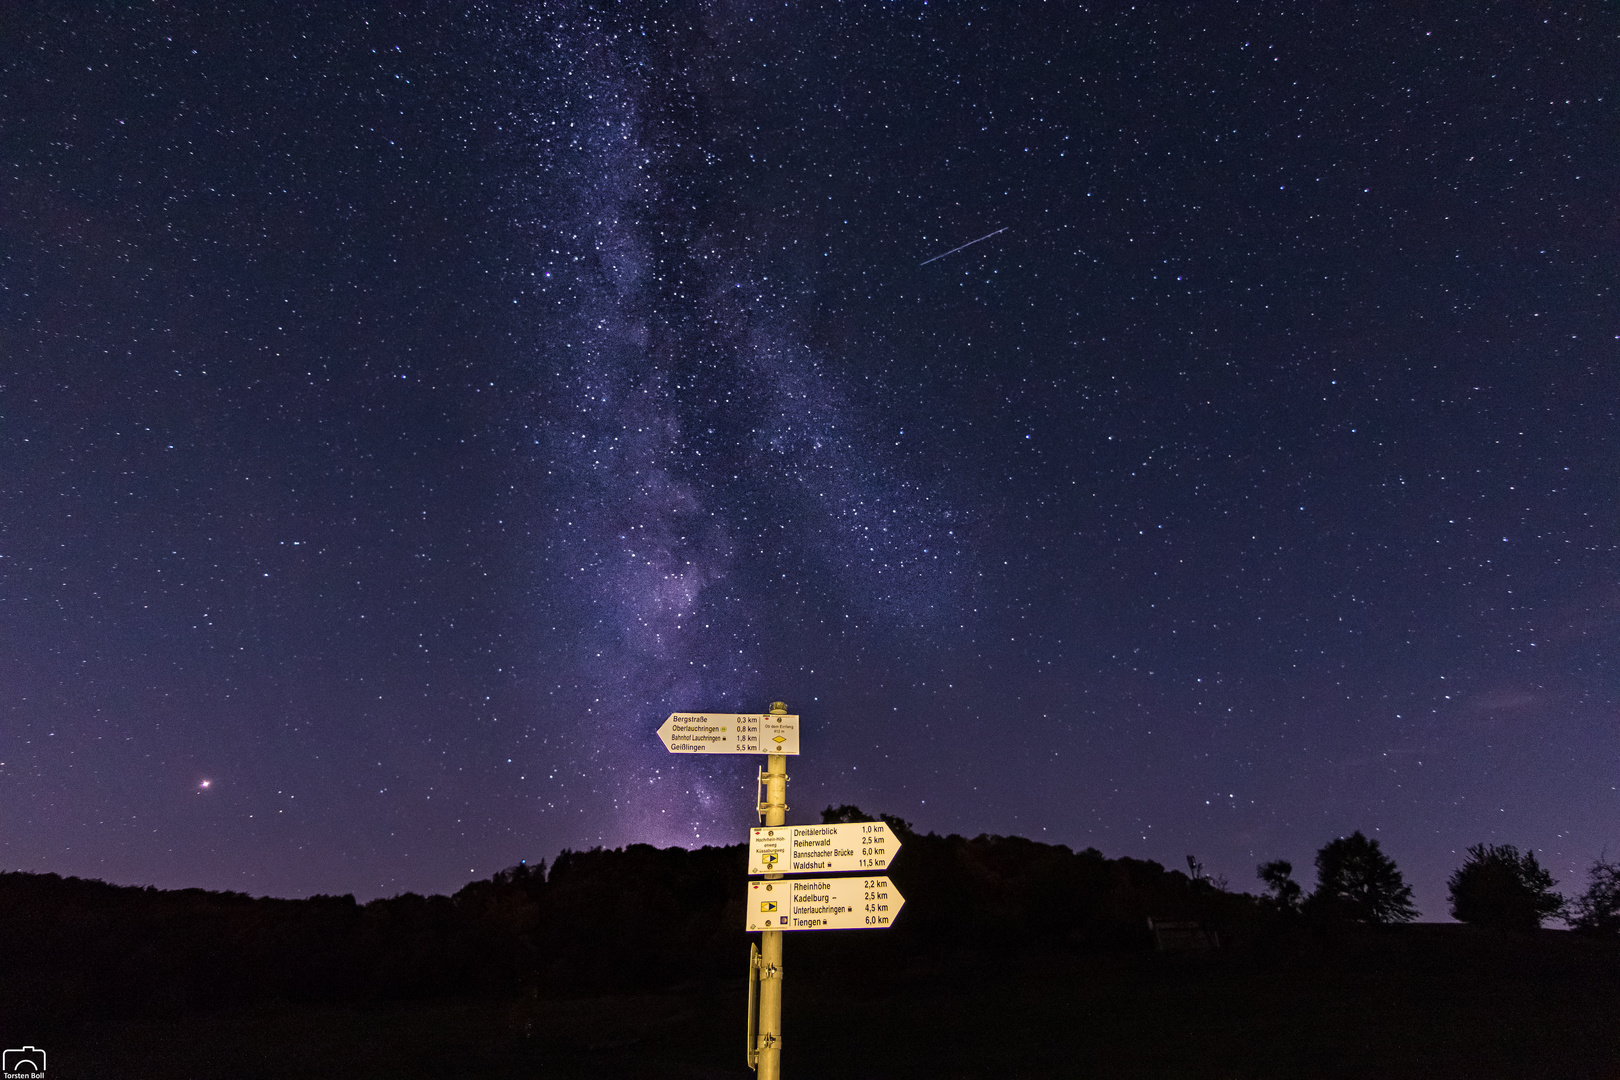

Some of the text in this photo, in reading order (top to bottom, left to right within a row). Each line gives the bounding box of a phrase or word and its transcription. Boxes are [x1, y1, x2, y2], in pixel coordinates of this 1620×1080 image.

[672, 725, 719, 733] Oberlauchringen
[692, 735, 721, 743] Lauchringen
[671, 744, 705, 752] Geißlingen
[794, 828, 838, 836] Dreitälerblick
[794, 839, 831, 847] Reiherwald
[794, 850, 833, 858] Bannschacher
[794, 882, 830, 890] Rheinhöhe
[794, 894, 829, 903] Kadelburg
[793, 905, 845, 915] Unterlauchringen
[865, 904, 875, 912] 4,5
[793, 918, 821, 927] Tiengen
[865, 916, 876, 924] 6,0
